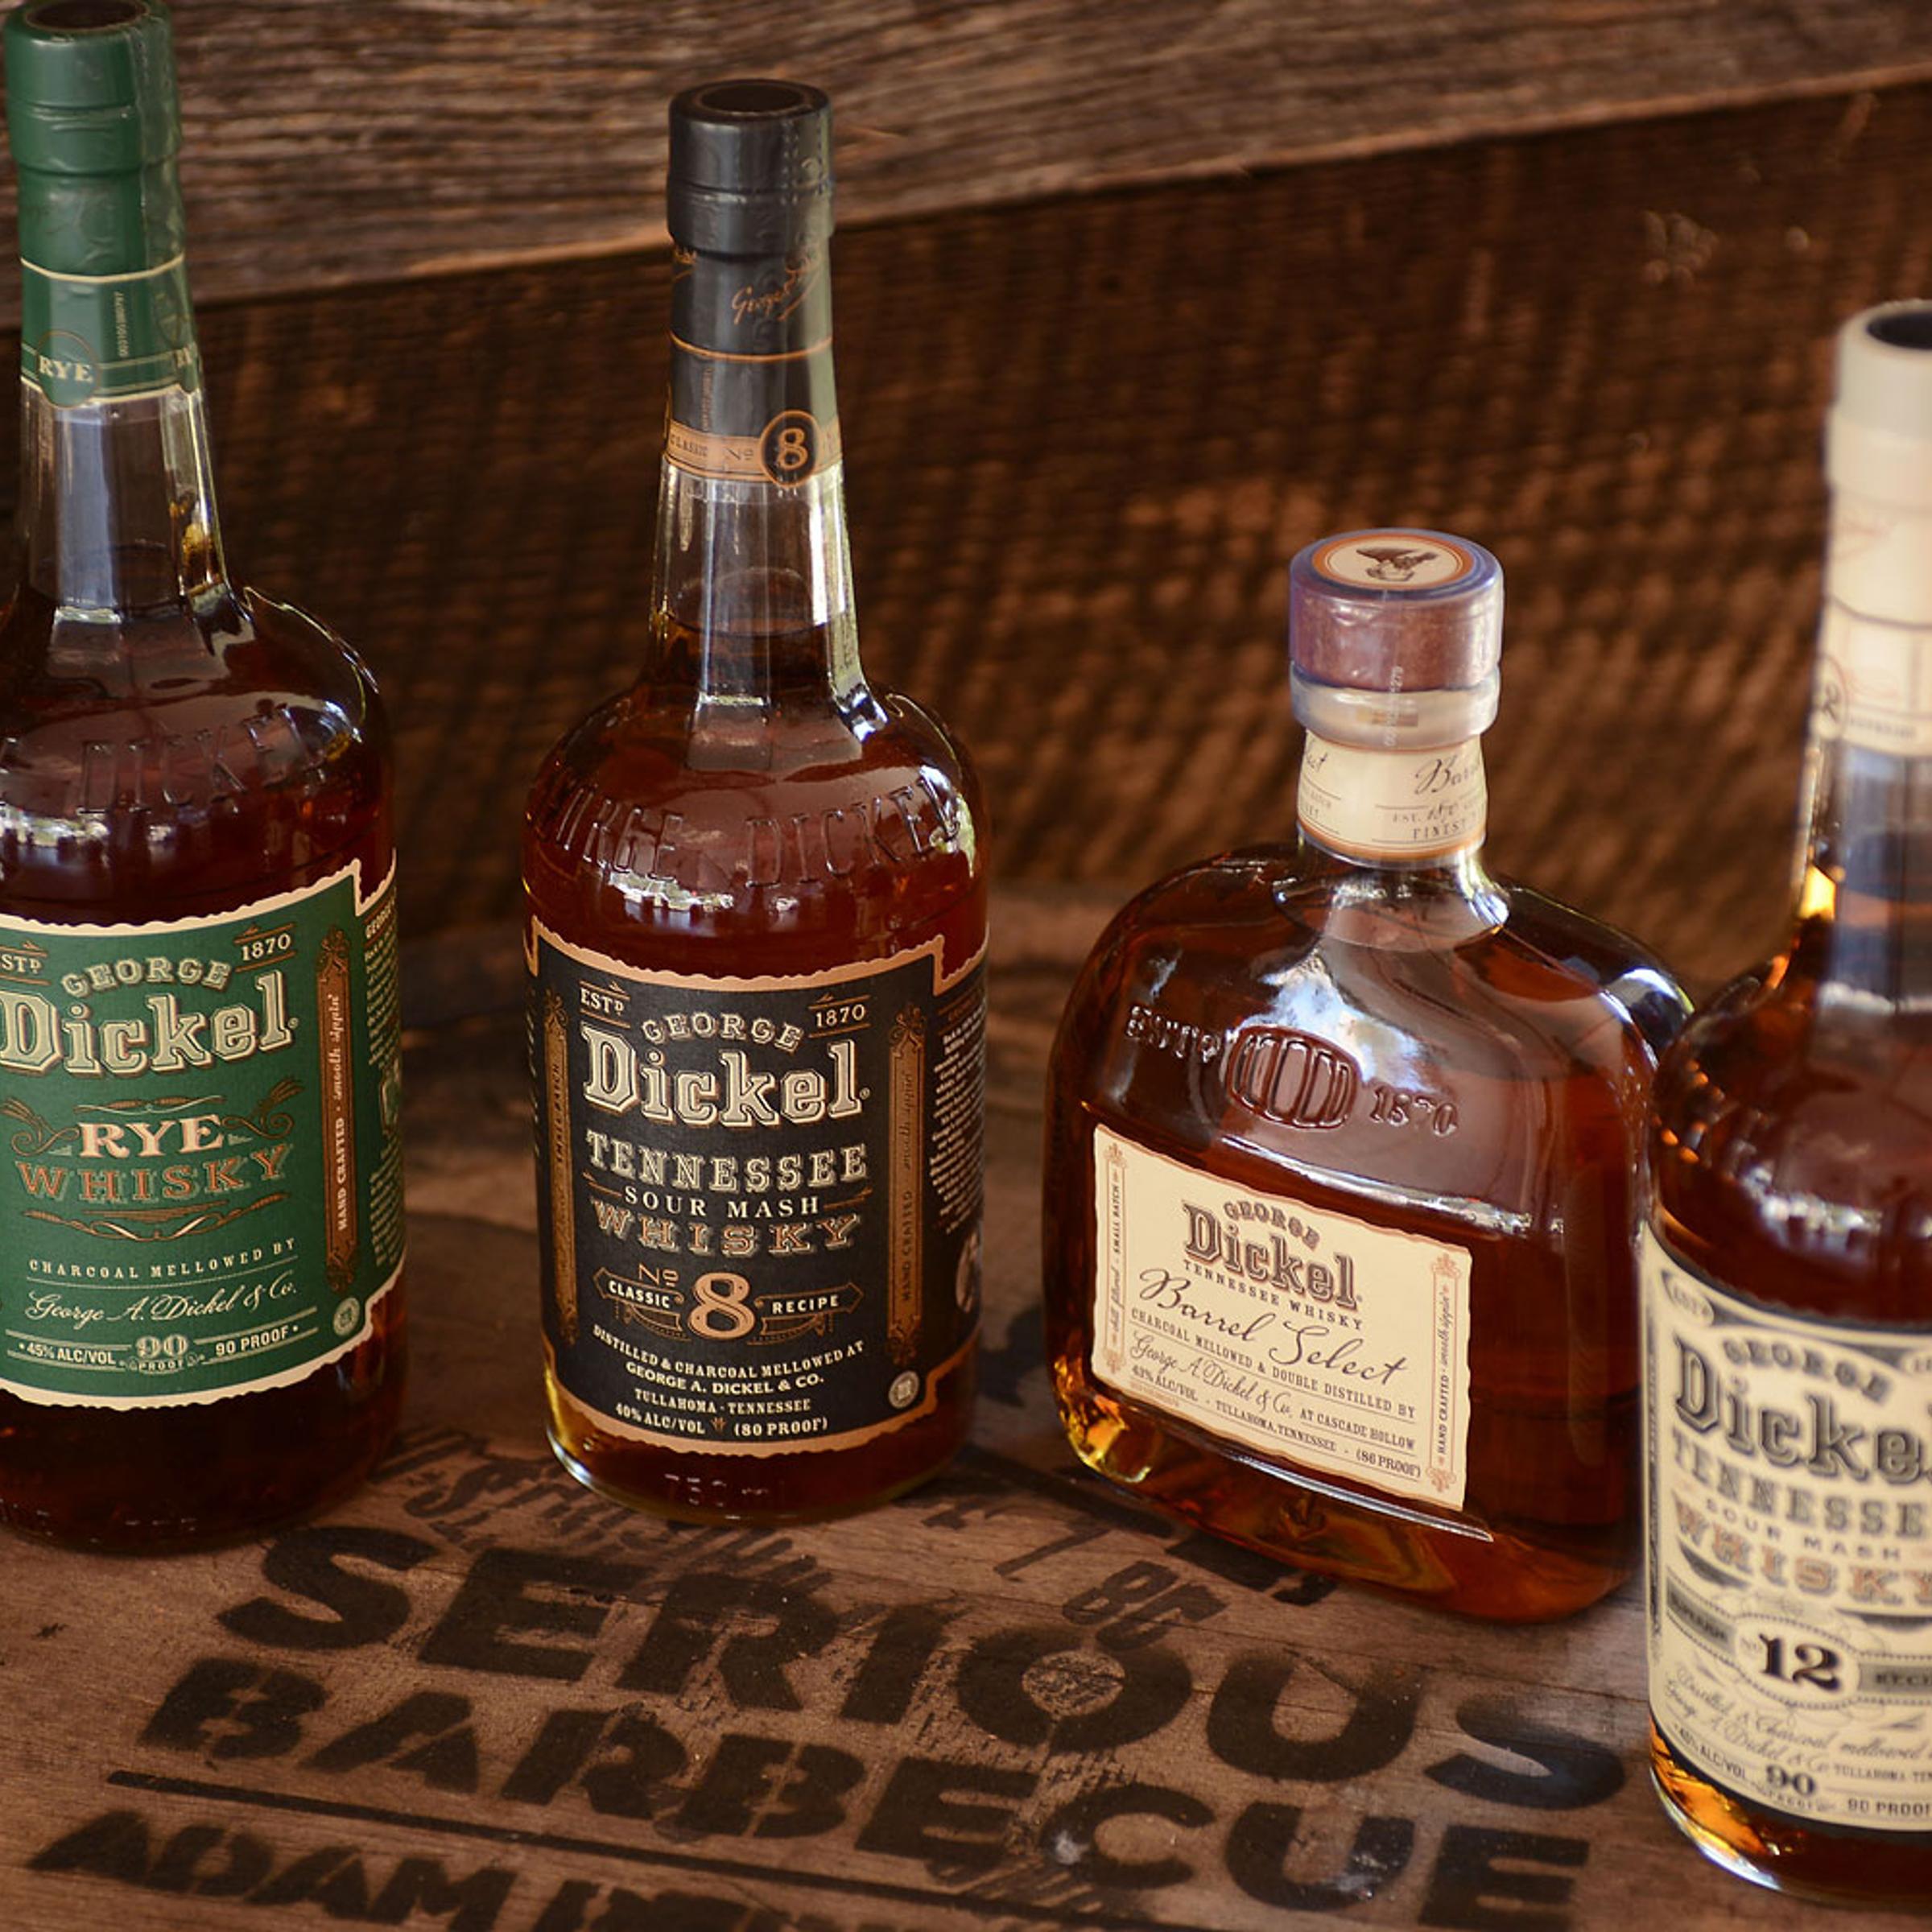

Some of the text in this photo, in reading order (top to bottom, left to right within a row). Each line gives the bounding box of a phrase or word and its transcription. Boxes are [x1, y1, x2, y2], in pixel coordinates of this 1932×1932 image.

[39, 355, 93, 383] RYE
[778, 427, 808, 471] 8
[0, 933, 292, 975] STD 1870
[60, 956, 233, 998] GEORGE
[0, 969, 295, 1077] Dickel
[641, 1011, 804, 1053] GEORGE
[815, 1003, 866, 1028] 1870
[580, 1022, 864, 1128] Dickel
[78, 1113, 225, 1158] RYE
[584, 1128, 871, 1194] TENNESSEE
[15, 1142, 294, 1204] WHISKY
[588, 1197, 862, 1258] WHISKY
[624, 1186, 819, 1219] SOUR MASH
[1223, 1199, 1321, 1251] GEORGE
[29, 1237, 295, 1279] CHARCOAL MELLOWED BY
[1182, 1200, 1359, 1315] Dickel
[25, 1290, 105, 1330] George
[150, 1285, 245, 1322] Dickel
[608, 1272, 840, 1340] CLASSIC 8 RECIPE
[1183, 1259, 1364, 1331] TENNESSEE WHISKY
[135, 1334, 189, 1358] 90
[215, 1326, 290, 1356] 90 PROOF
[593, 1323, 865, 1379] DISTILLED & CHARCOAL MELLOWED AT
[1138, 1267, 1410, 1385] Barrel Select
[57, 1347, 117, 1366] ALC/VOL
[625, 1360, 825, 1396] GEORGE A. DICKEL & CO.
[1131, 1307, 1416, 1419] CHARCOAL MELLOWED & DOUBLE DISTILLED BY
[634, 1387, 811, 1415] TULLAHOMA TENNESSEE
[1129, 1330, 1179, 1374] George
[1202, 1359, 1260, 1402] Dickel
[1299, 1408, 1315, 1422] AT
[1316, 1410, 1368, 1435] CASCADE
[1369, 1428, 1416, 1449] HOLLOW
[1154, 1375, 1199, 1402] ALC/VOL
[1674, 1331, 1932, 1485] Dicke
[615, 1402, 642, 1422] 40%
[644, 1414, 706, 1435] ALC/VOL
[766, 1417, 829, 1436] PROOF)
[1671, 1425, 1932, 1539] TENNESSE
[216, 1525, 1626, 1811] SERIOUS
[1758, 1633, 1841, 1692] 12
[137, 1655, 1591, 1932] BARBECUE
[1765, 1764, 1818, 1799] 90
[26, 1808, 518, 1932] ADAM
